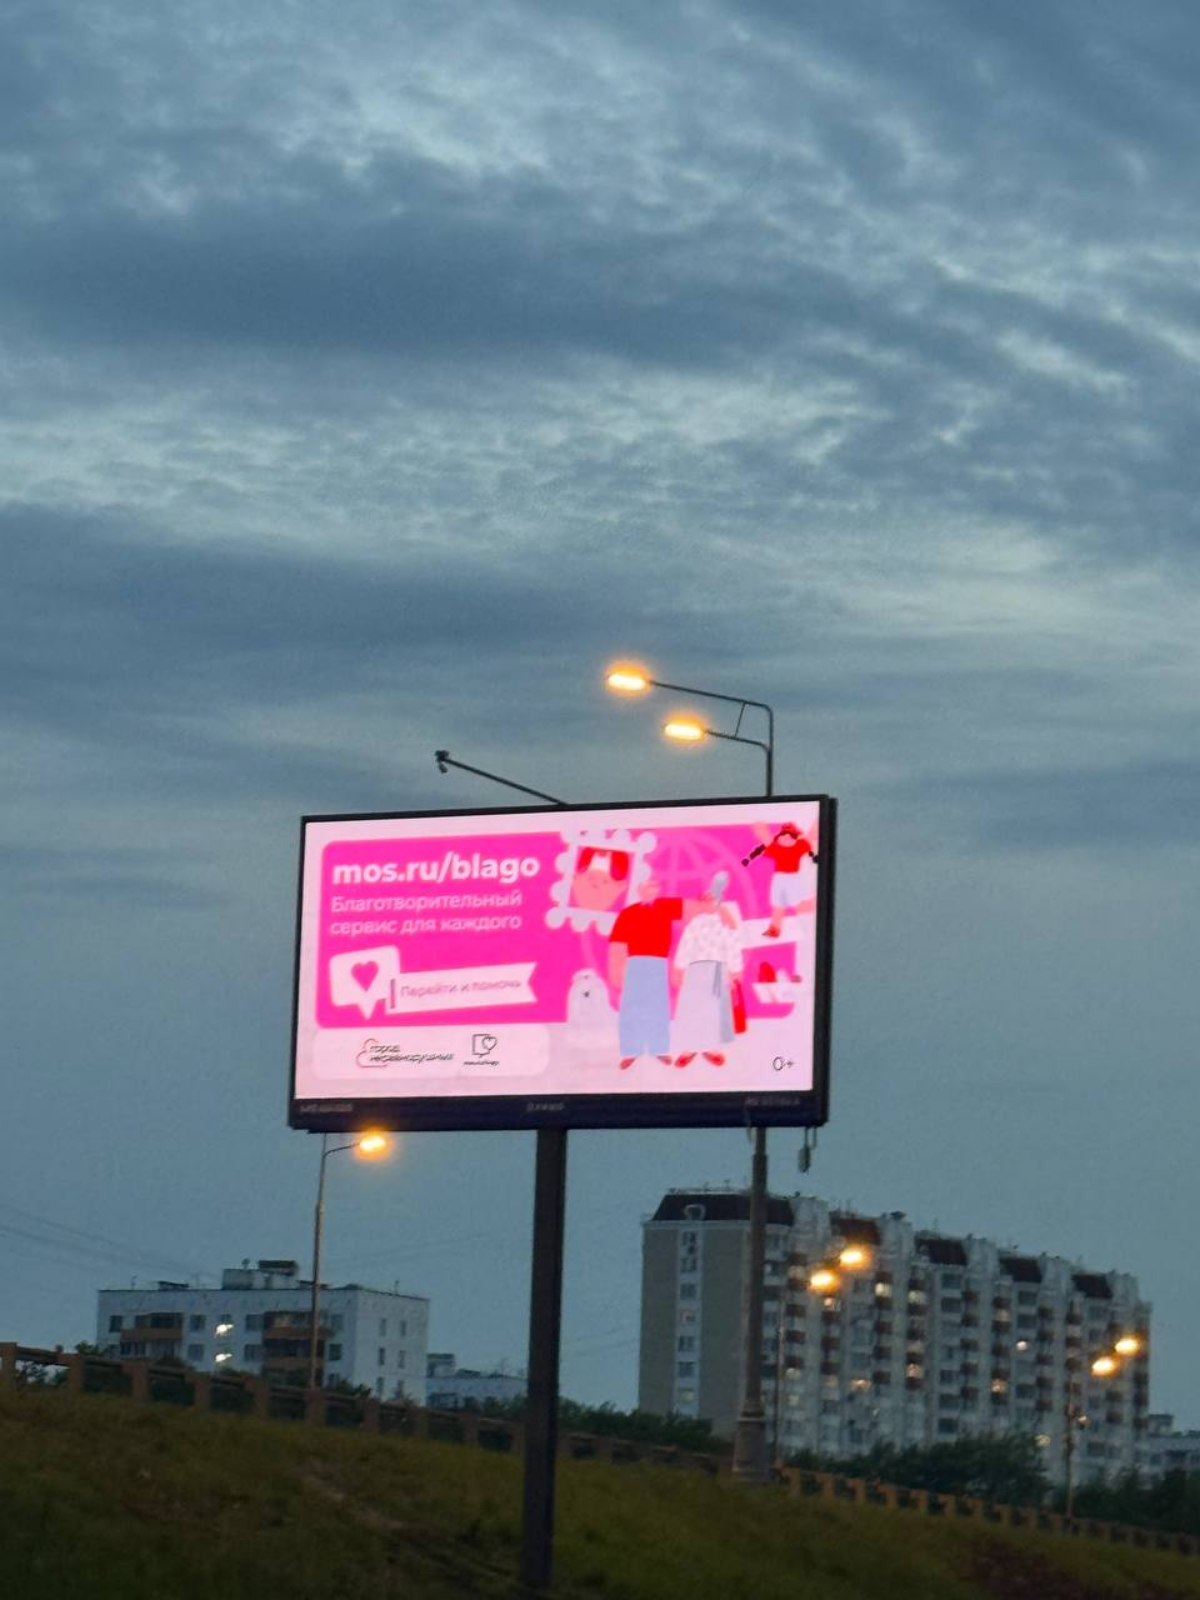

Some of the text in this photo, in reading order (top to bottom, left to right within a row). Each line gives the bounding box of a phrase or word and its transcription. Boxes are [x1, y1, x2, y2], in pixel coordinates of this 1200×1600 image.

[332, 851, 540, 885] mos.ru/blago
[331, 889, 522, 913] Благотворительный
[330, 915, 523, 937] сервис для каждого
[772, 1056, 795, 1071] 0+
